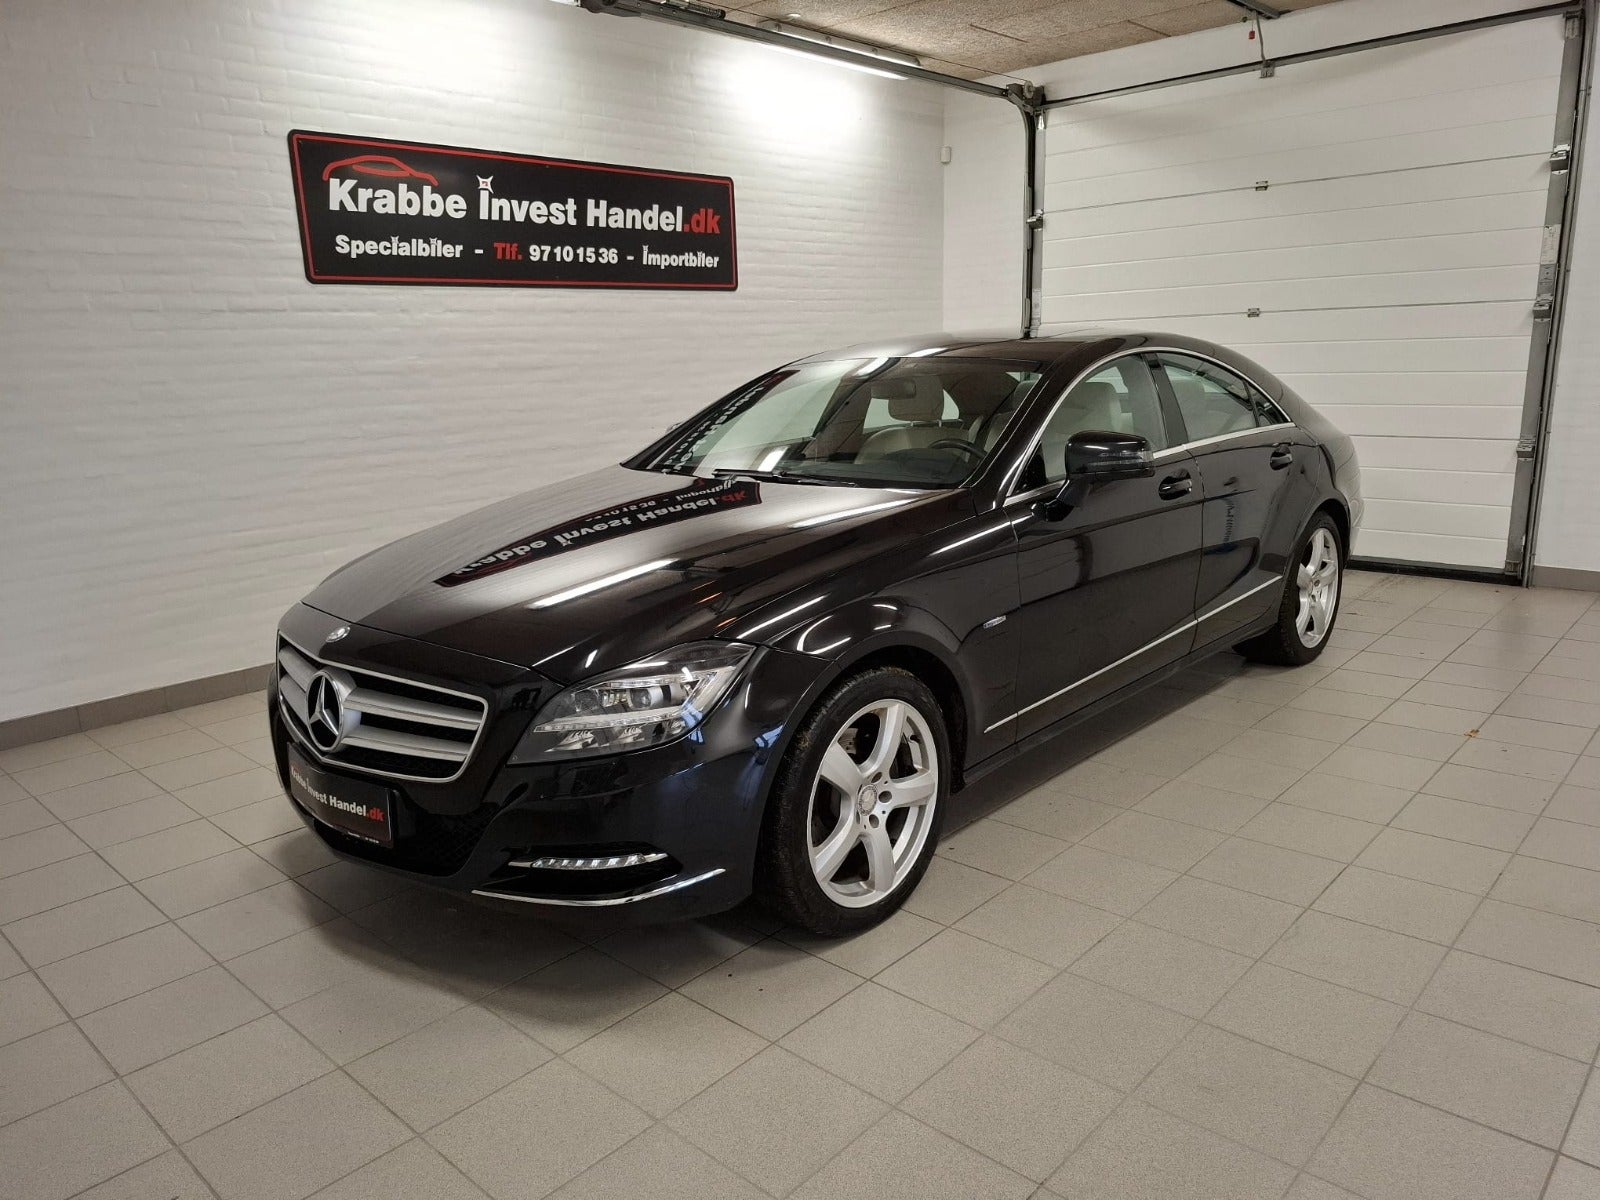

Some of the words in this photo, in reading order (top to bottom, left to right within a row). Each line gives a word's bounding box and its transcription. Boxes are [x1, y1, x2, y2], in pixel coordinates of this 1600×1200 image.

[329, 178, 467, 219] Krabbe
[477, 175, 577, 226] Invest
[586, 198, 721, 234] Handel.dk
[335, 234, 464, 258] Specialbiler
[493, 242, 523, 260] Tlf.
[642, 245, 720, 269] Importbiler
[329, 795, 386, 822] Handel.dk
